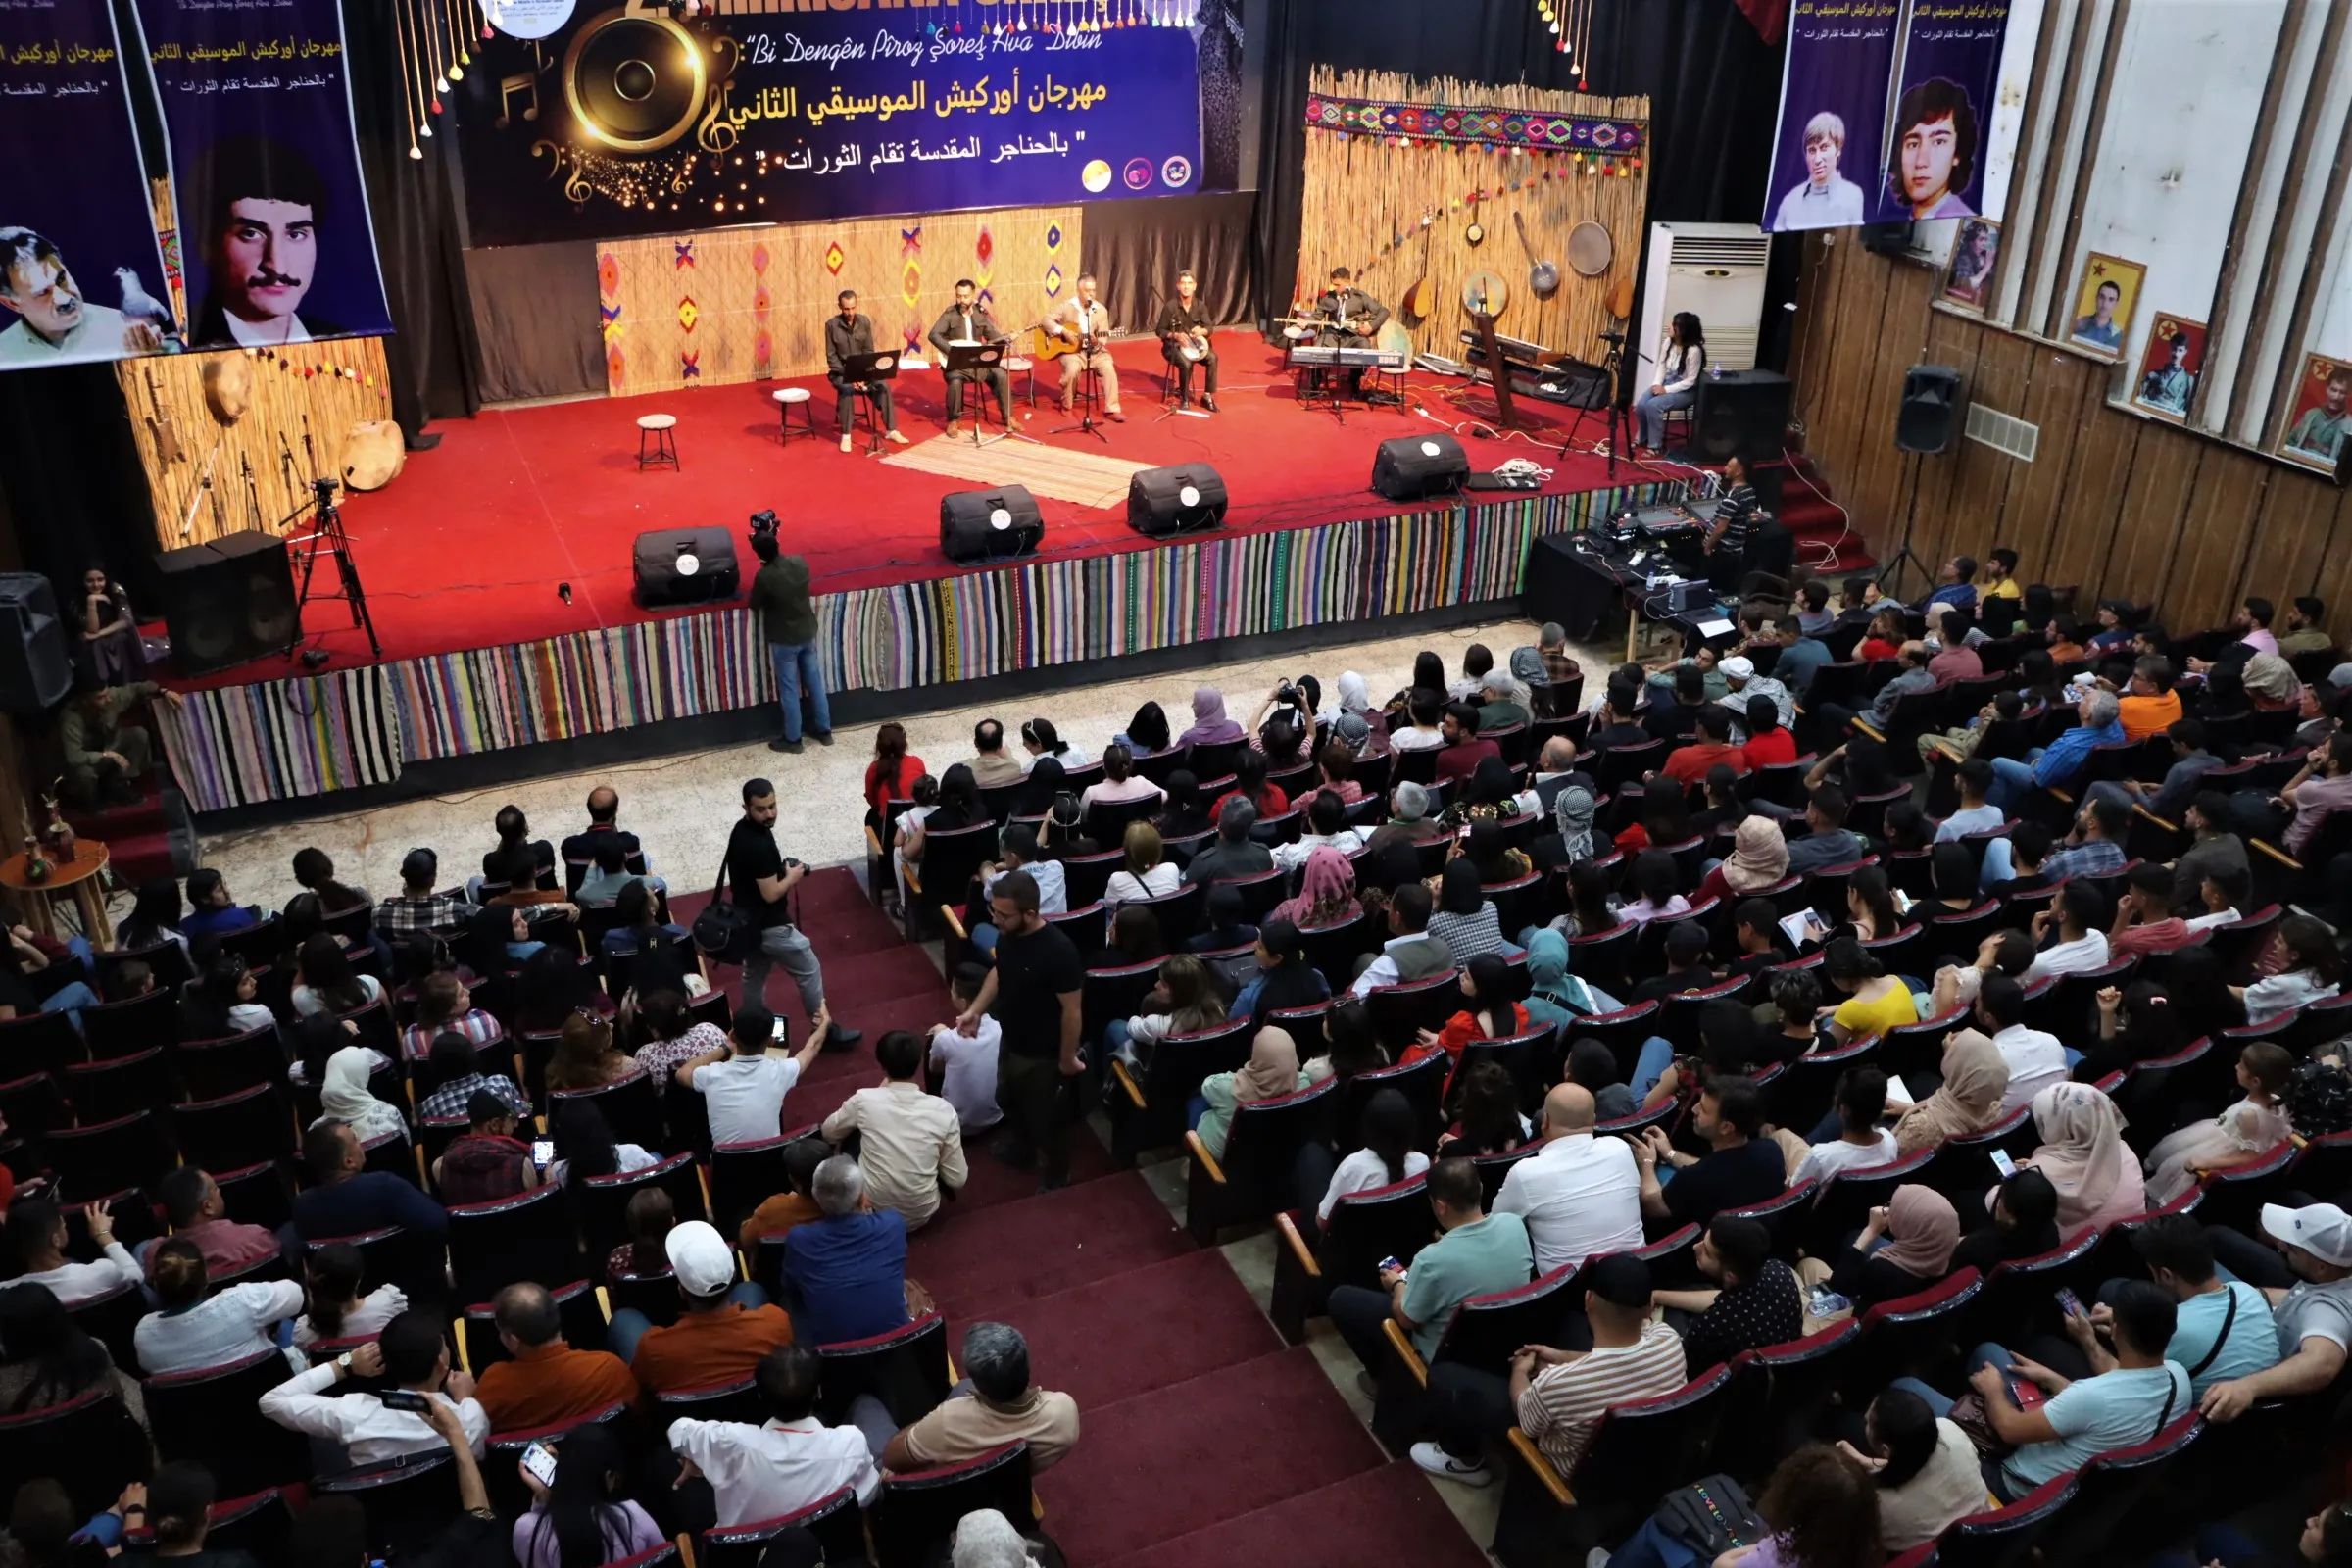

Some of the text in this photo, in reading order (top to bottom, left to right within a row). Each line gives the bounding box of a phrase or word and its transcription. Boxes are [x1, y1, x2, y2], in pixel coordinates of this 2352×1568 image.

[11, 38, 61, 65] أوركيش
[66, 42, 115, 64] مهرجان
[150, 35, 343, 64] مهرجان أوركيش الموسيقي الثاني
[782, 32, 866, 71] Dengên
[871, 28, 925, 67] Pîroz
[929, 27, 987, 63] Şoreş
[3, 82, 47, 96] المقدسة
[53, 80, 100, 98] بالحناجر
[179, 79, 218, 95] الثورات
[222, 78, 240, 94] تقام
[243, 76, 280, 89] المقدسة
[286, 74, 326, 90] بالحناجر
[728, 67, 1107, 131] مهرجان أوركيش الموسيقي الثاني
[869, 140, 905, 174] تقام
[910, 136, 981, 161] المقدسة
[990, 130, 1069, 164] بالحناجر
[783, 143, 862, 175] الثورات
[1378, 355, 1400, 365] KORG
